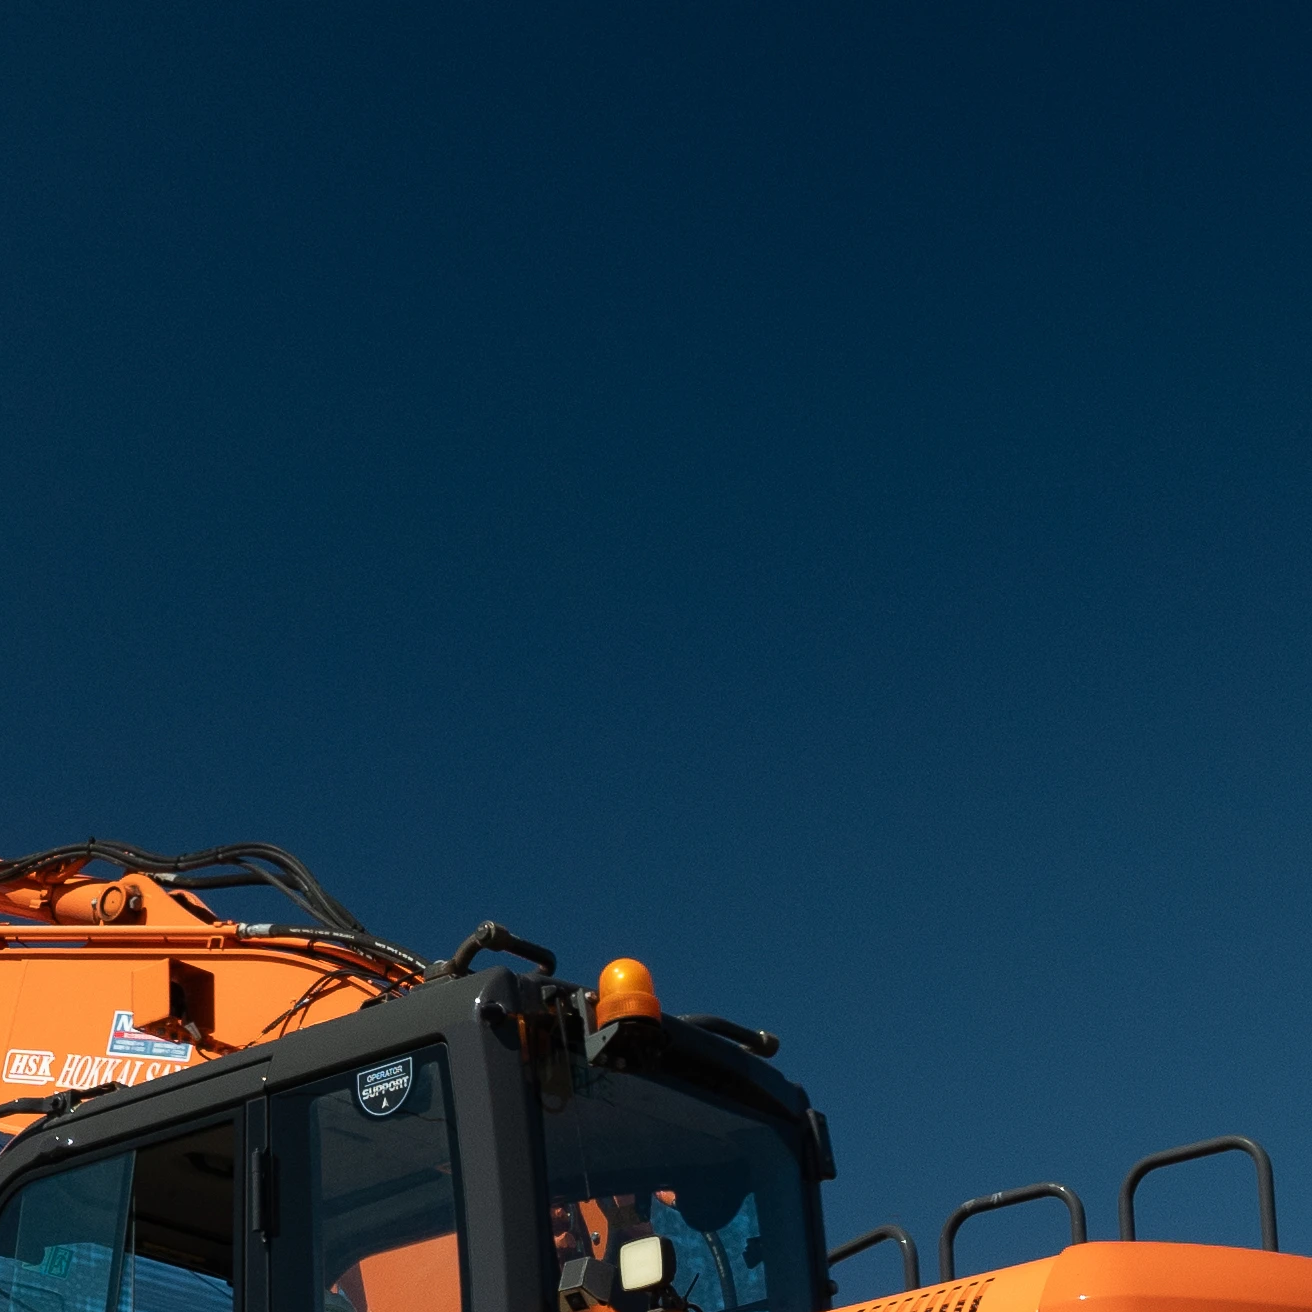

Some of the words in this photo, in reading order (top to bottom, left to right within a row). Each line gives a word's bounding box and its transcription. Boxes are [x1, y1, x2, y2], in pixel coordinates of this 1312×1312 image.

[10, 1054, 55, 1076] HSK
[366, 1065, 403, 1083] OPERATOR
[361, 1075, 409, 1100] SUPPORT
